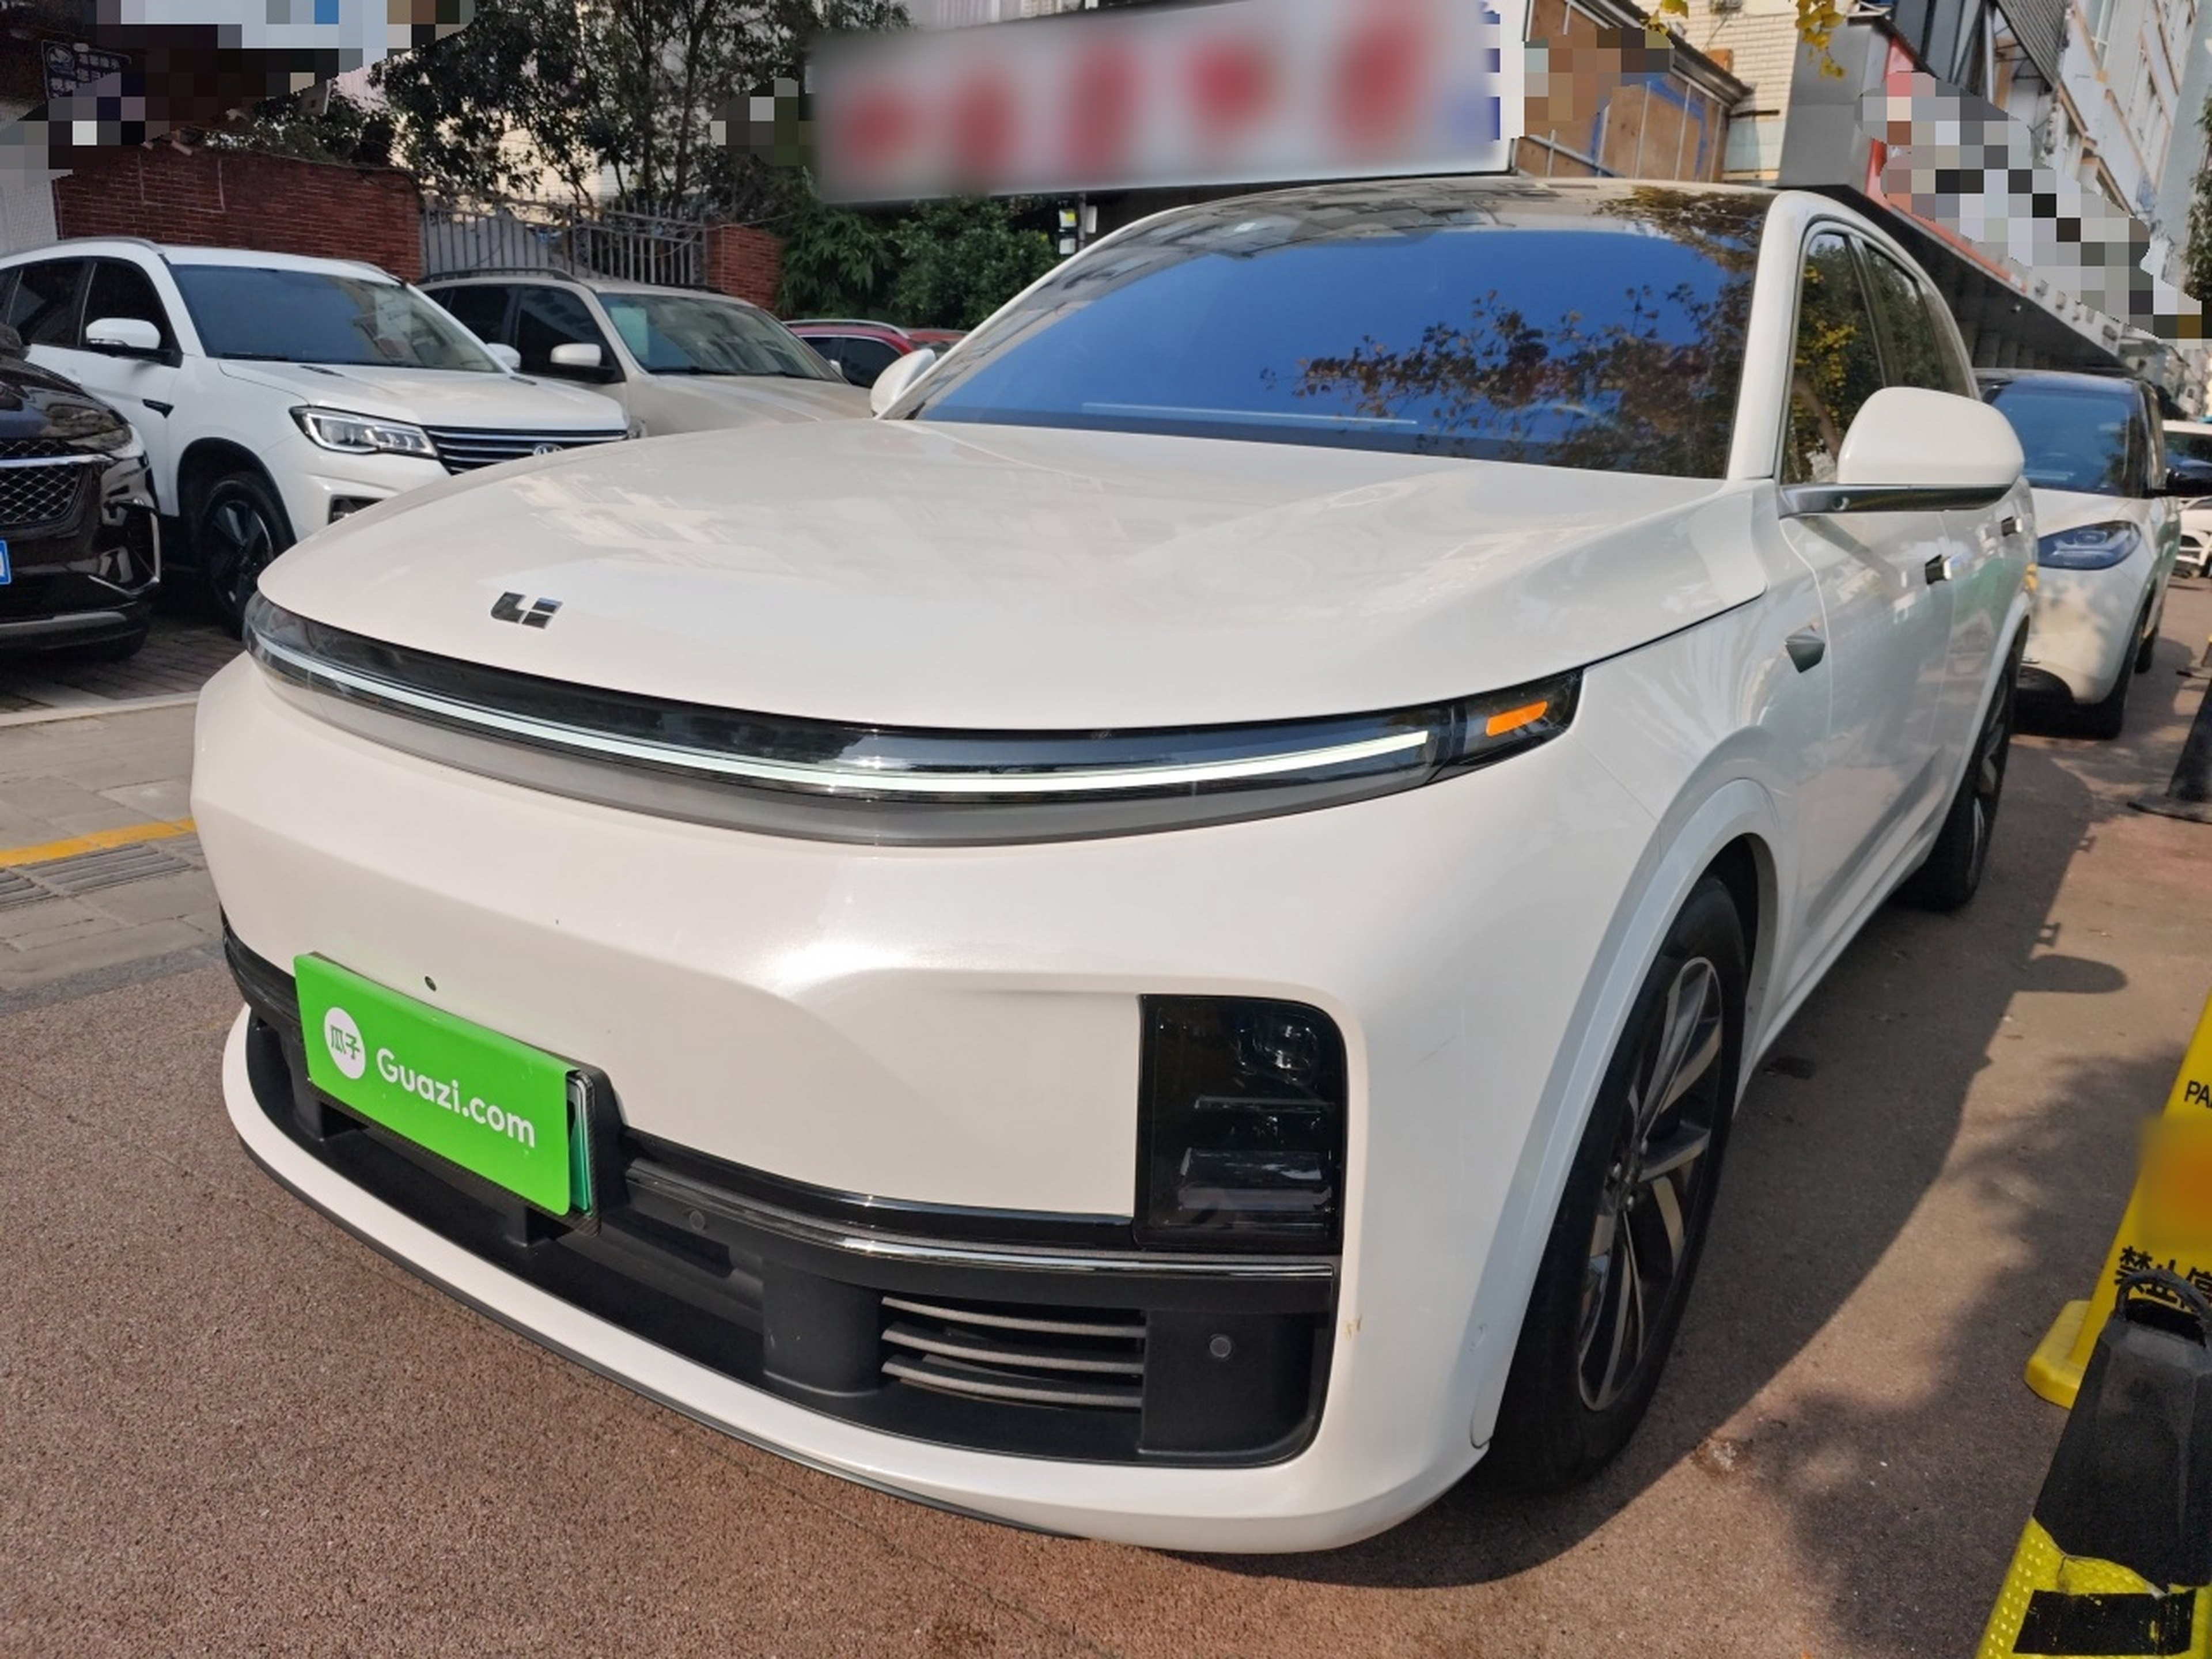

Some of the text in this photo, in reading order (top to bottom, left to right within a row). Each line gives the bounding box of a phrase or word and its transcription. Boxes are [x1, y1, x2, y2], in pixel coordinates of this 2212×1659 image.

[330, 1024, 360, 1059] 瓜子
[376, 1048, 535, 1148] Guazi.com
[2184, 1080, 2212, 1109] PA
